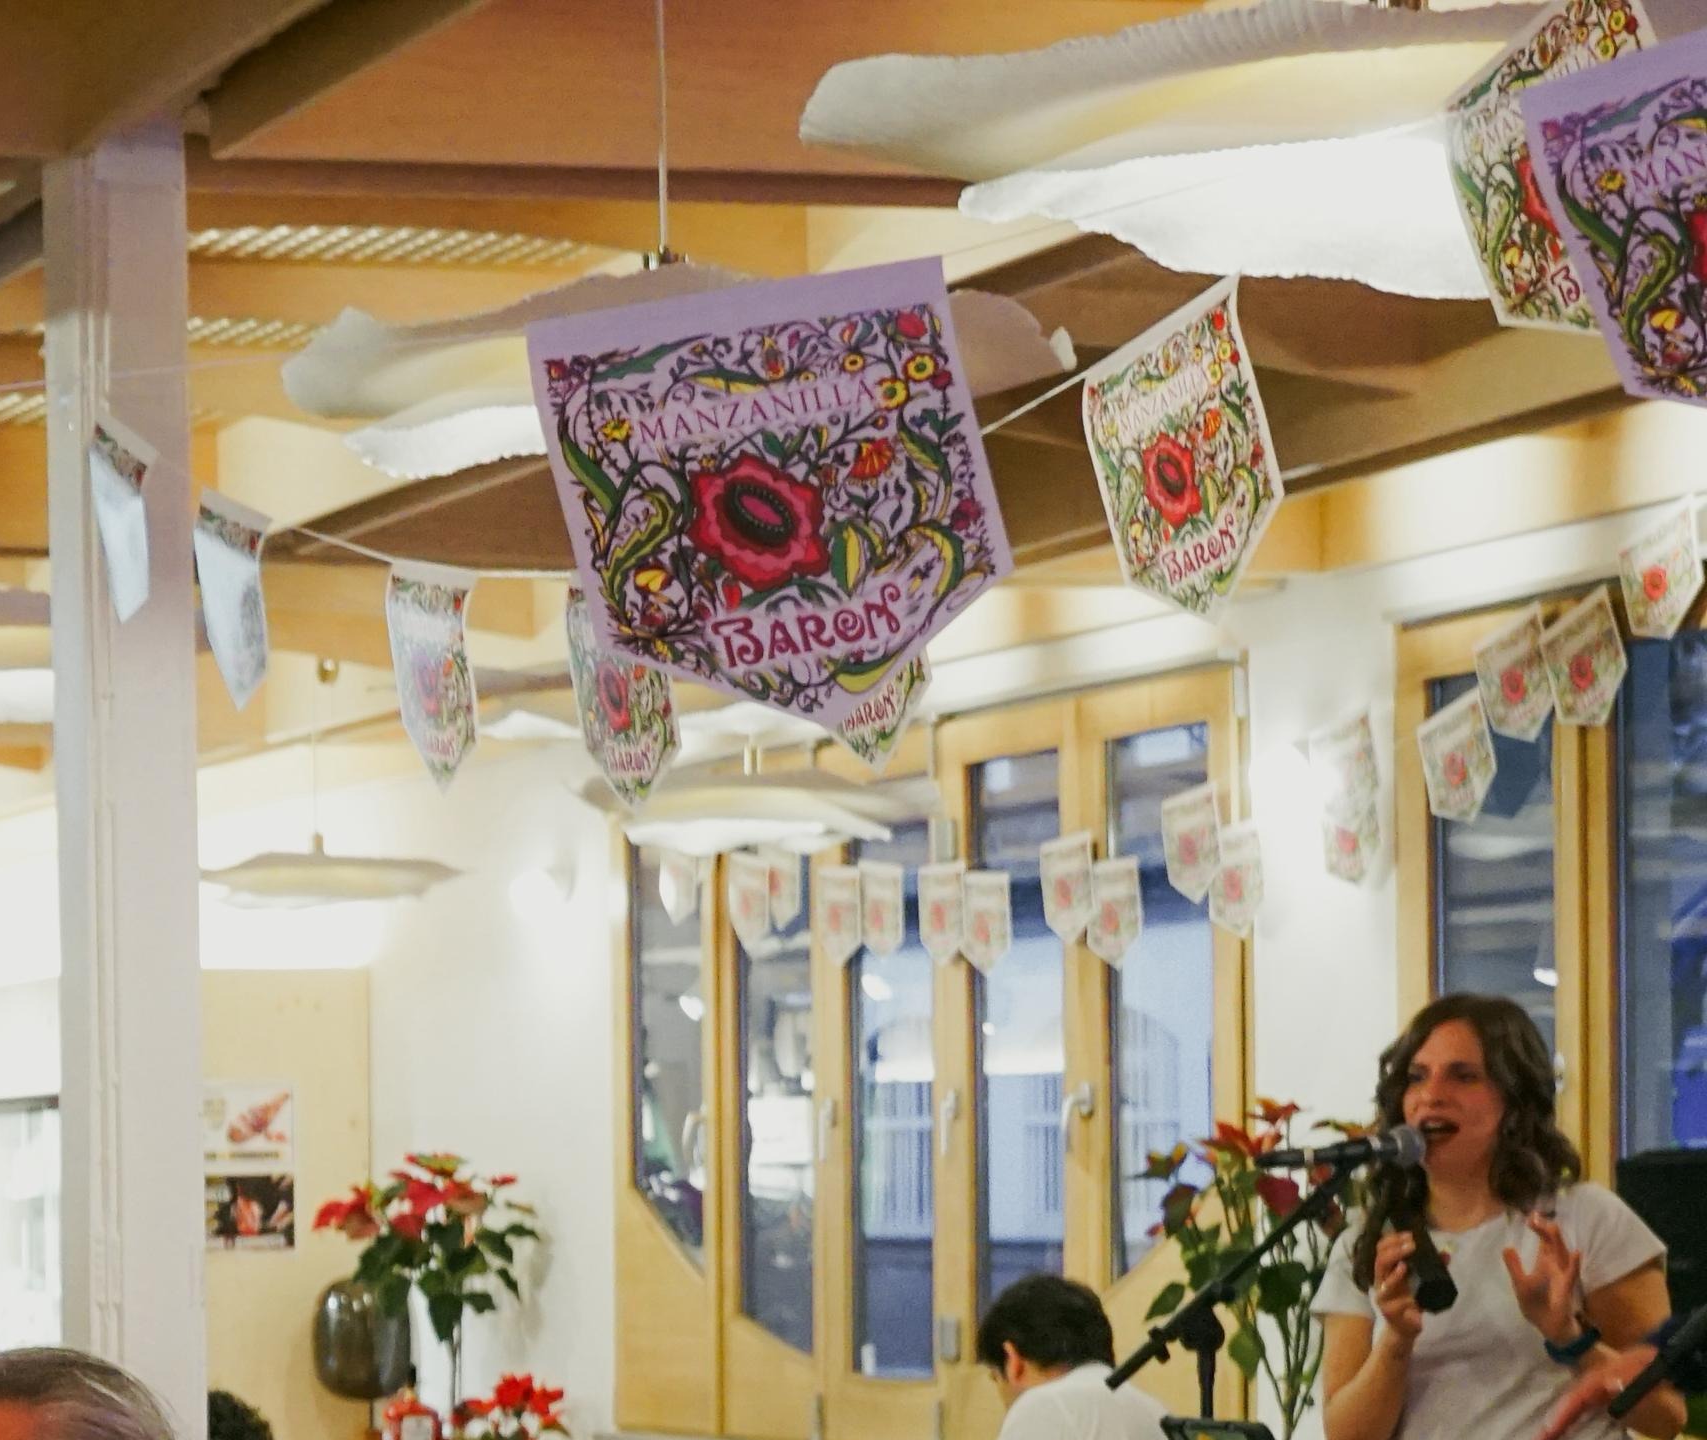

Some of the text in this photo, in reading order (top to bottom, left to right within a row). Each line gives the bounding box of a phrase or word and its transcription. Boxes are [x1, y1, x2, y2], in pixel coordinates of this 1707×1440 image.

[637, 380, 878, 444] MANZANILLA
[1161, 512, 1236, 586] BARON
[711, 582, 902, 669] BARON
